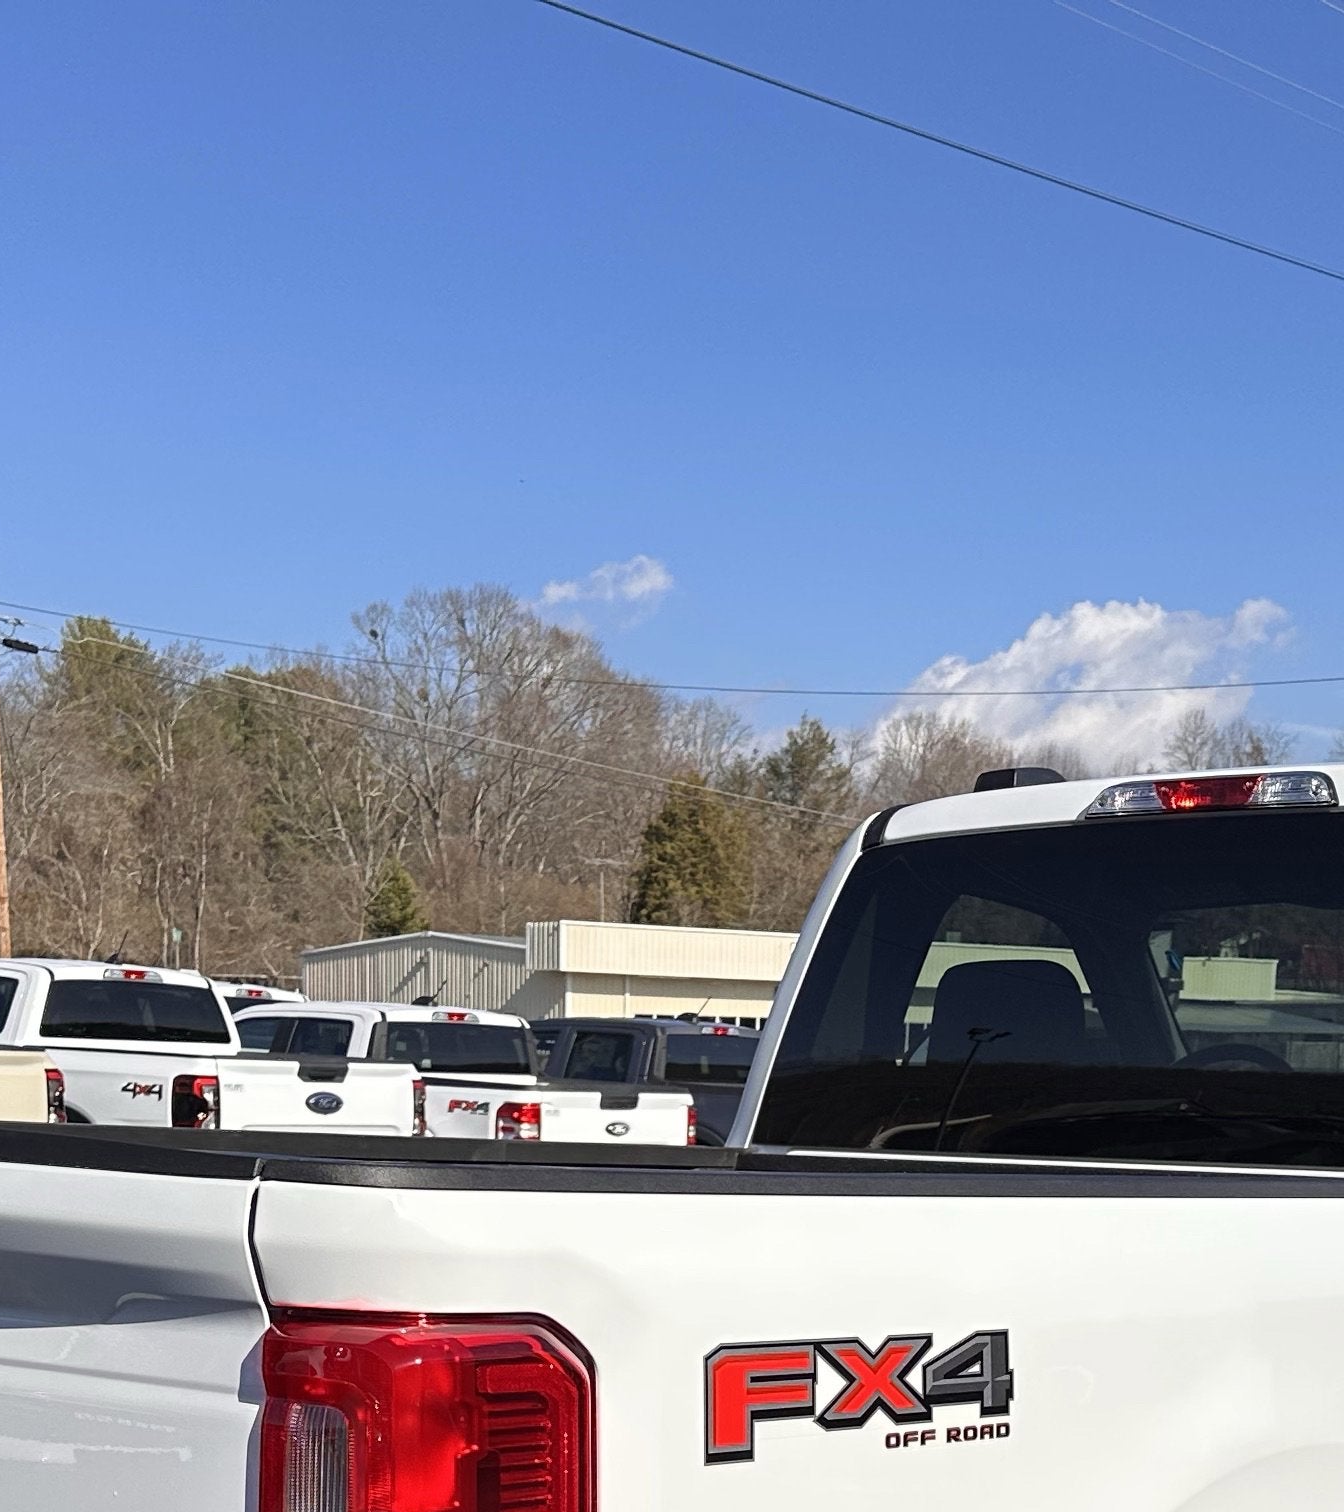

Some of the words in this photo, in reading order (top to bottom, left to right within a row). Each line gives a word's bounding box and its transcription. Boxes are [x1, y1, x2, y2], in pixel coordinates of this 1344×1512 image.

[704, 1329, 1014, 1466] FX4
[885, 1429, 936, 1449] OFF
[946, 1422, 1010, 1443] ROAD
